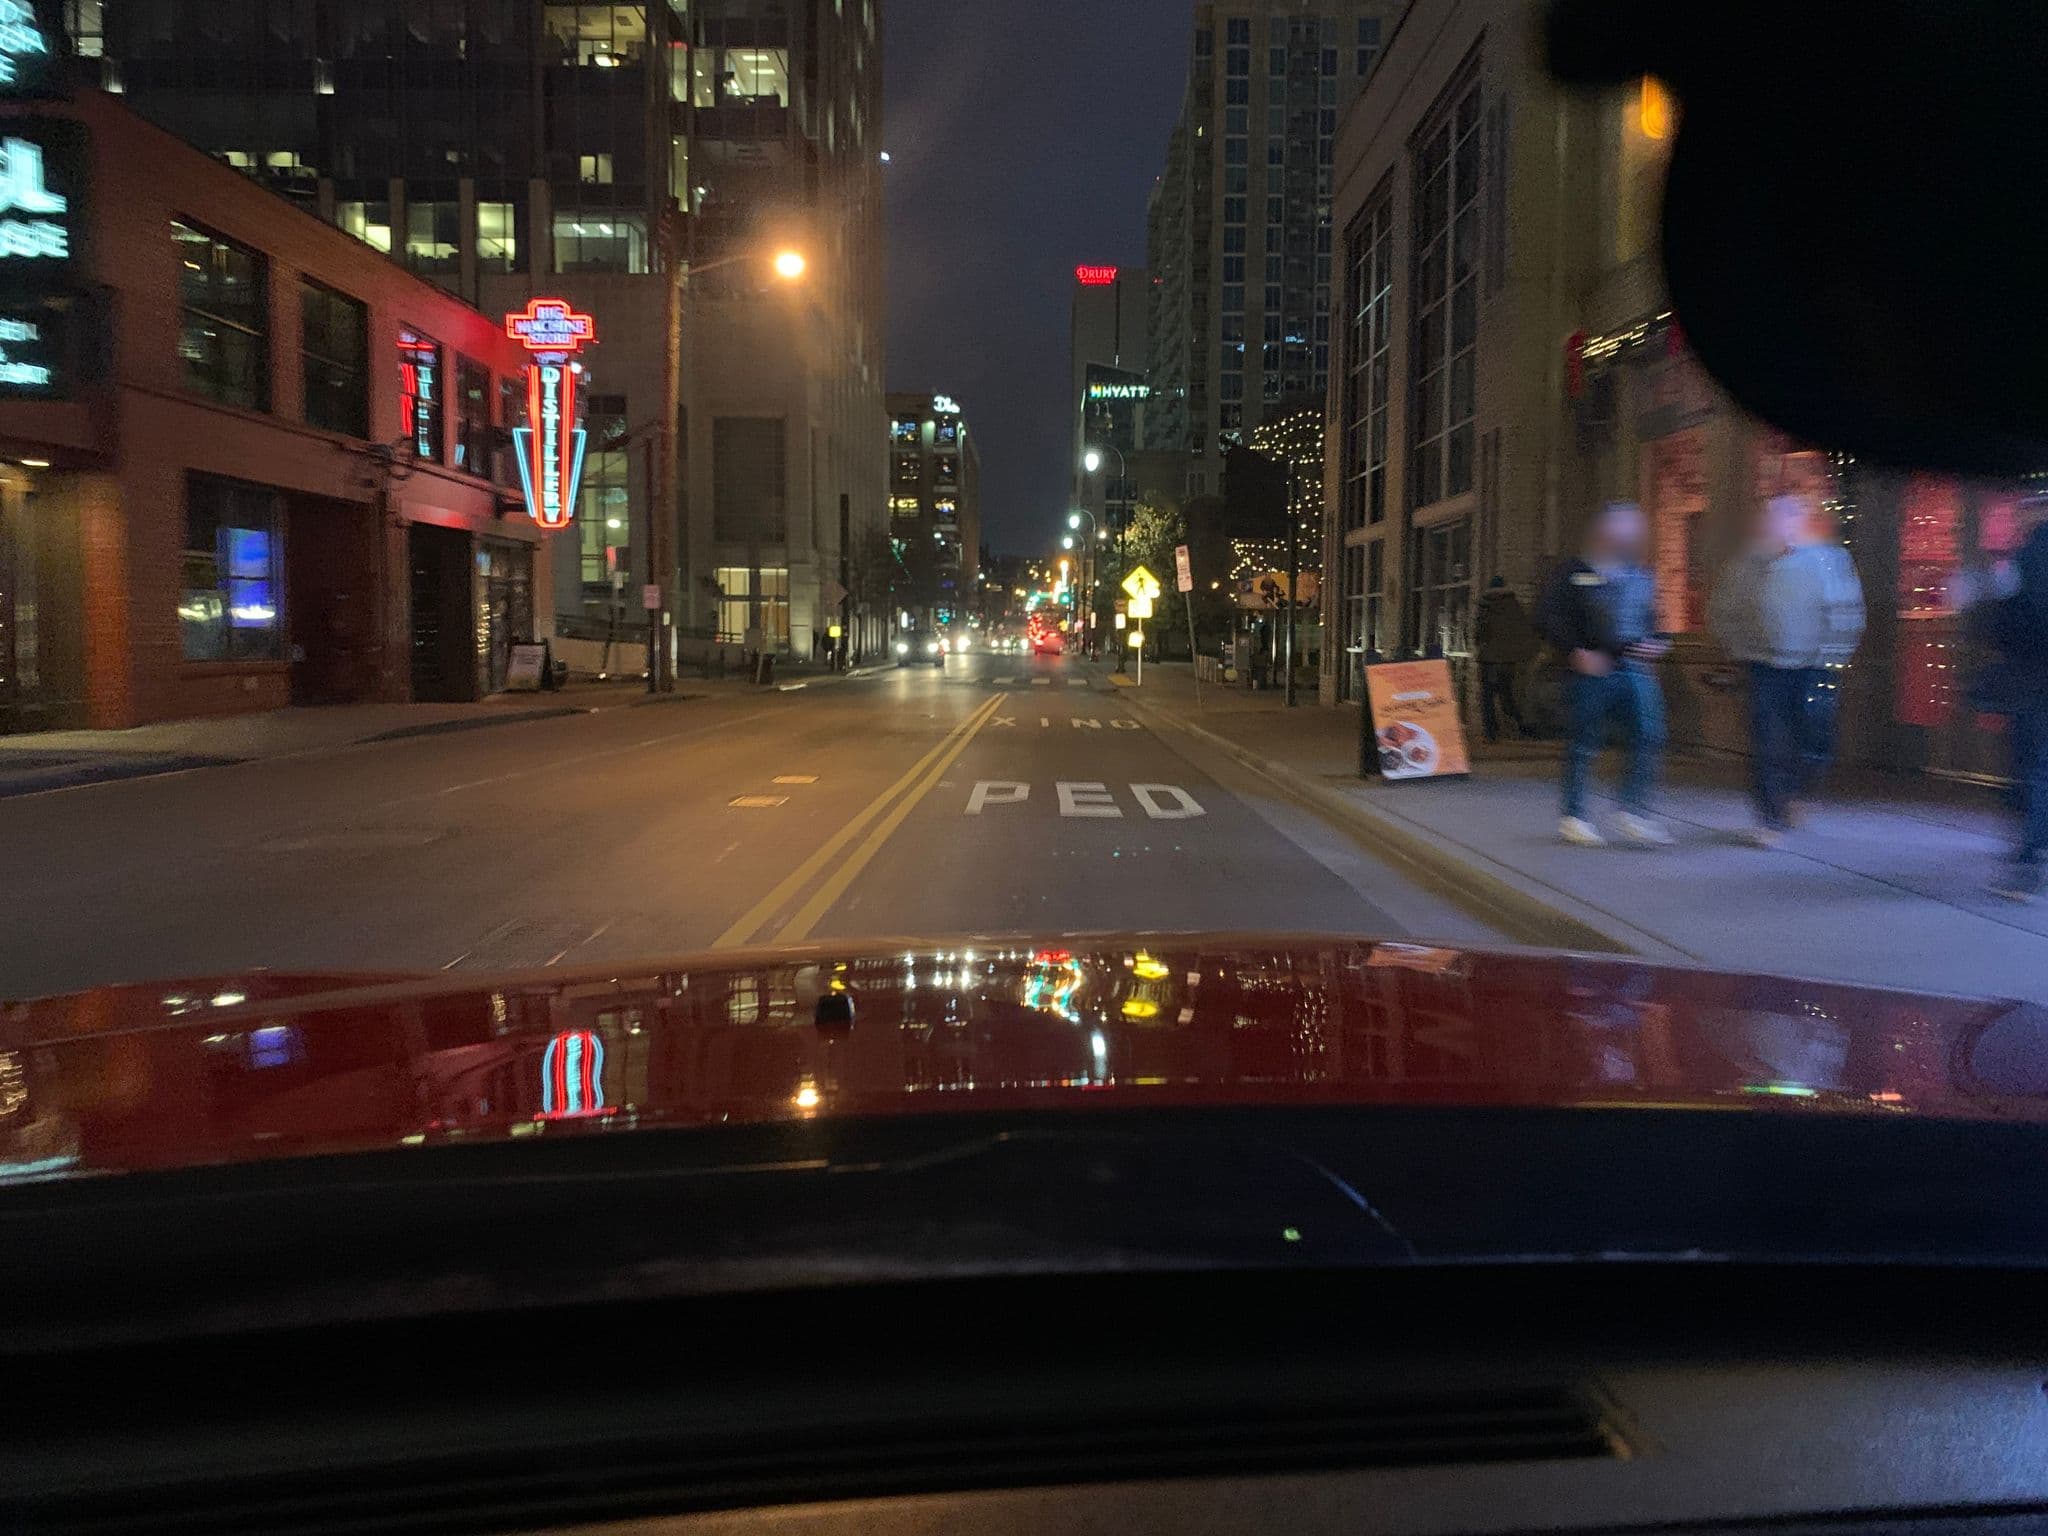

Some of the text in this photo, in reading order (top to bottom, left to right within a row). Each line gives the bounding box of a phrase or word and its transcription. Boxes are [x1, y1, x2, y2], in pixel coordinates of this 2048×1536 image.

[1076, 267, 1117, 279] DRURY
[536, 306, 565, 319] BIG
[515, 319, 587, 334] MACHINE
[541, 366, 562, 523] DISTILLERY
[962, 780, 1208, 820] PED
